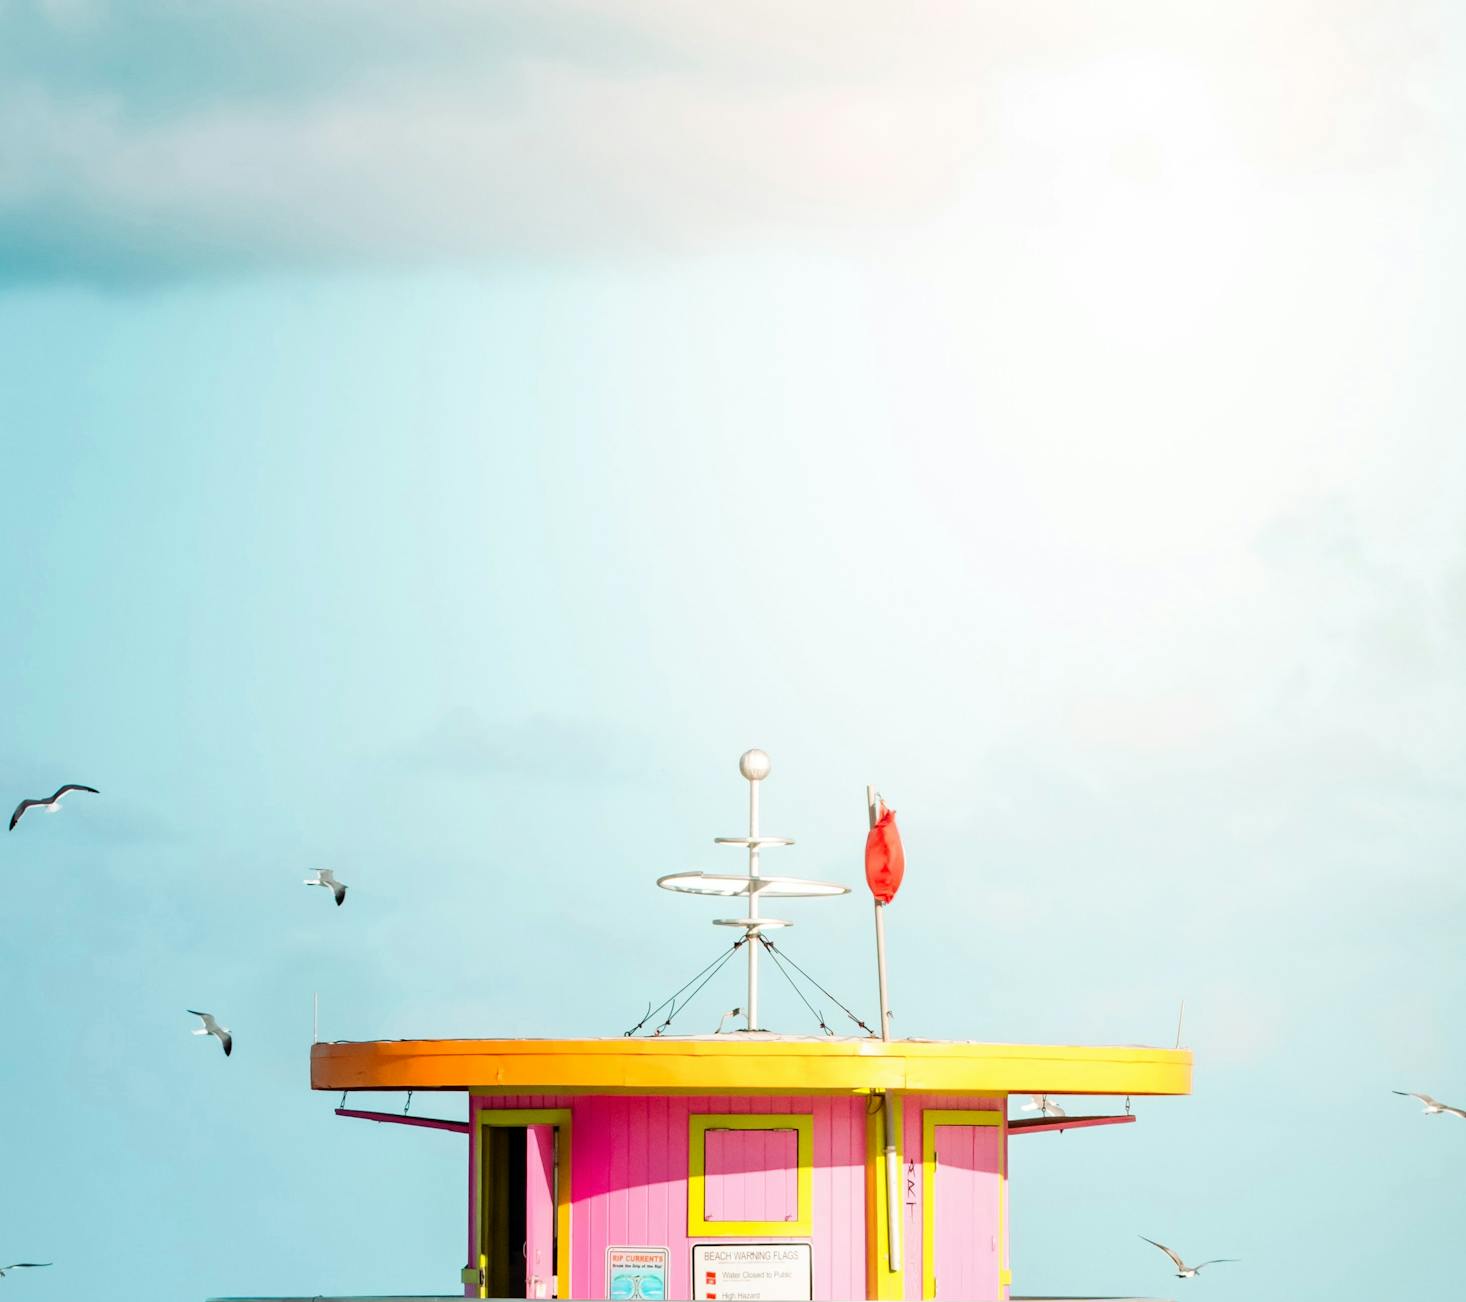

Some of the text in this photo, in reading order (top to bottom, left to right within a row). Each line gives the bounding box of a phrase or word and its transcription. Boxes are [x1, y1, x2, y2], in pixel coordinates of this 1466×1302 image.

[704, 1250, 799, 1261] BEACH WARNING FLAGS
[722, 1271, 741, 1279] Water
[742, 1271, 765, 1279] Closed
[722, 1292, 761, 1302] High Hazard
